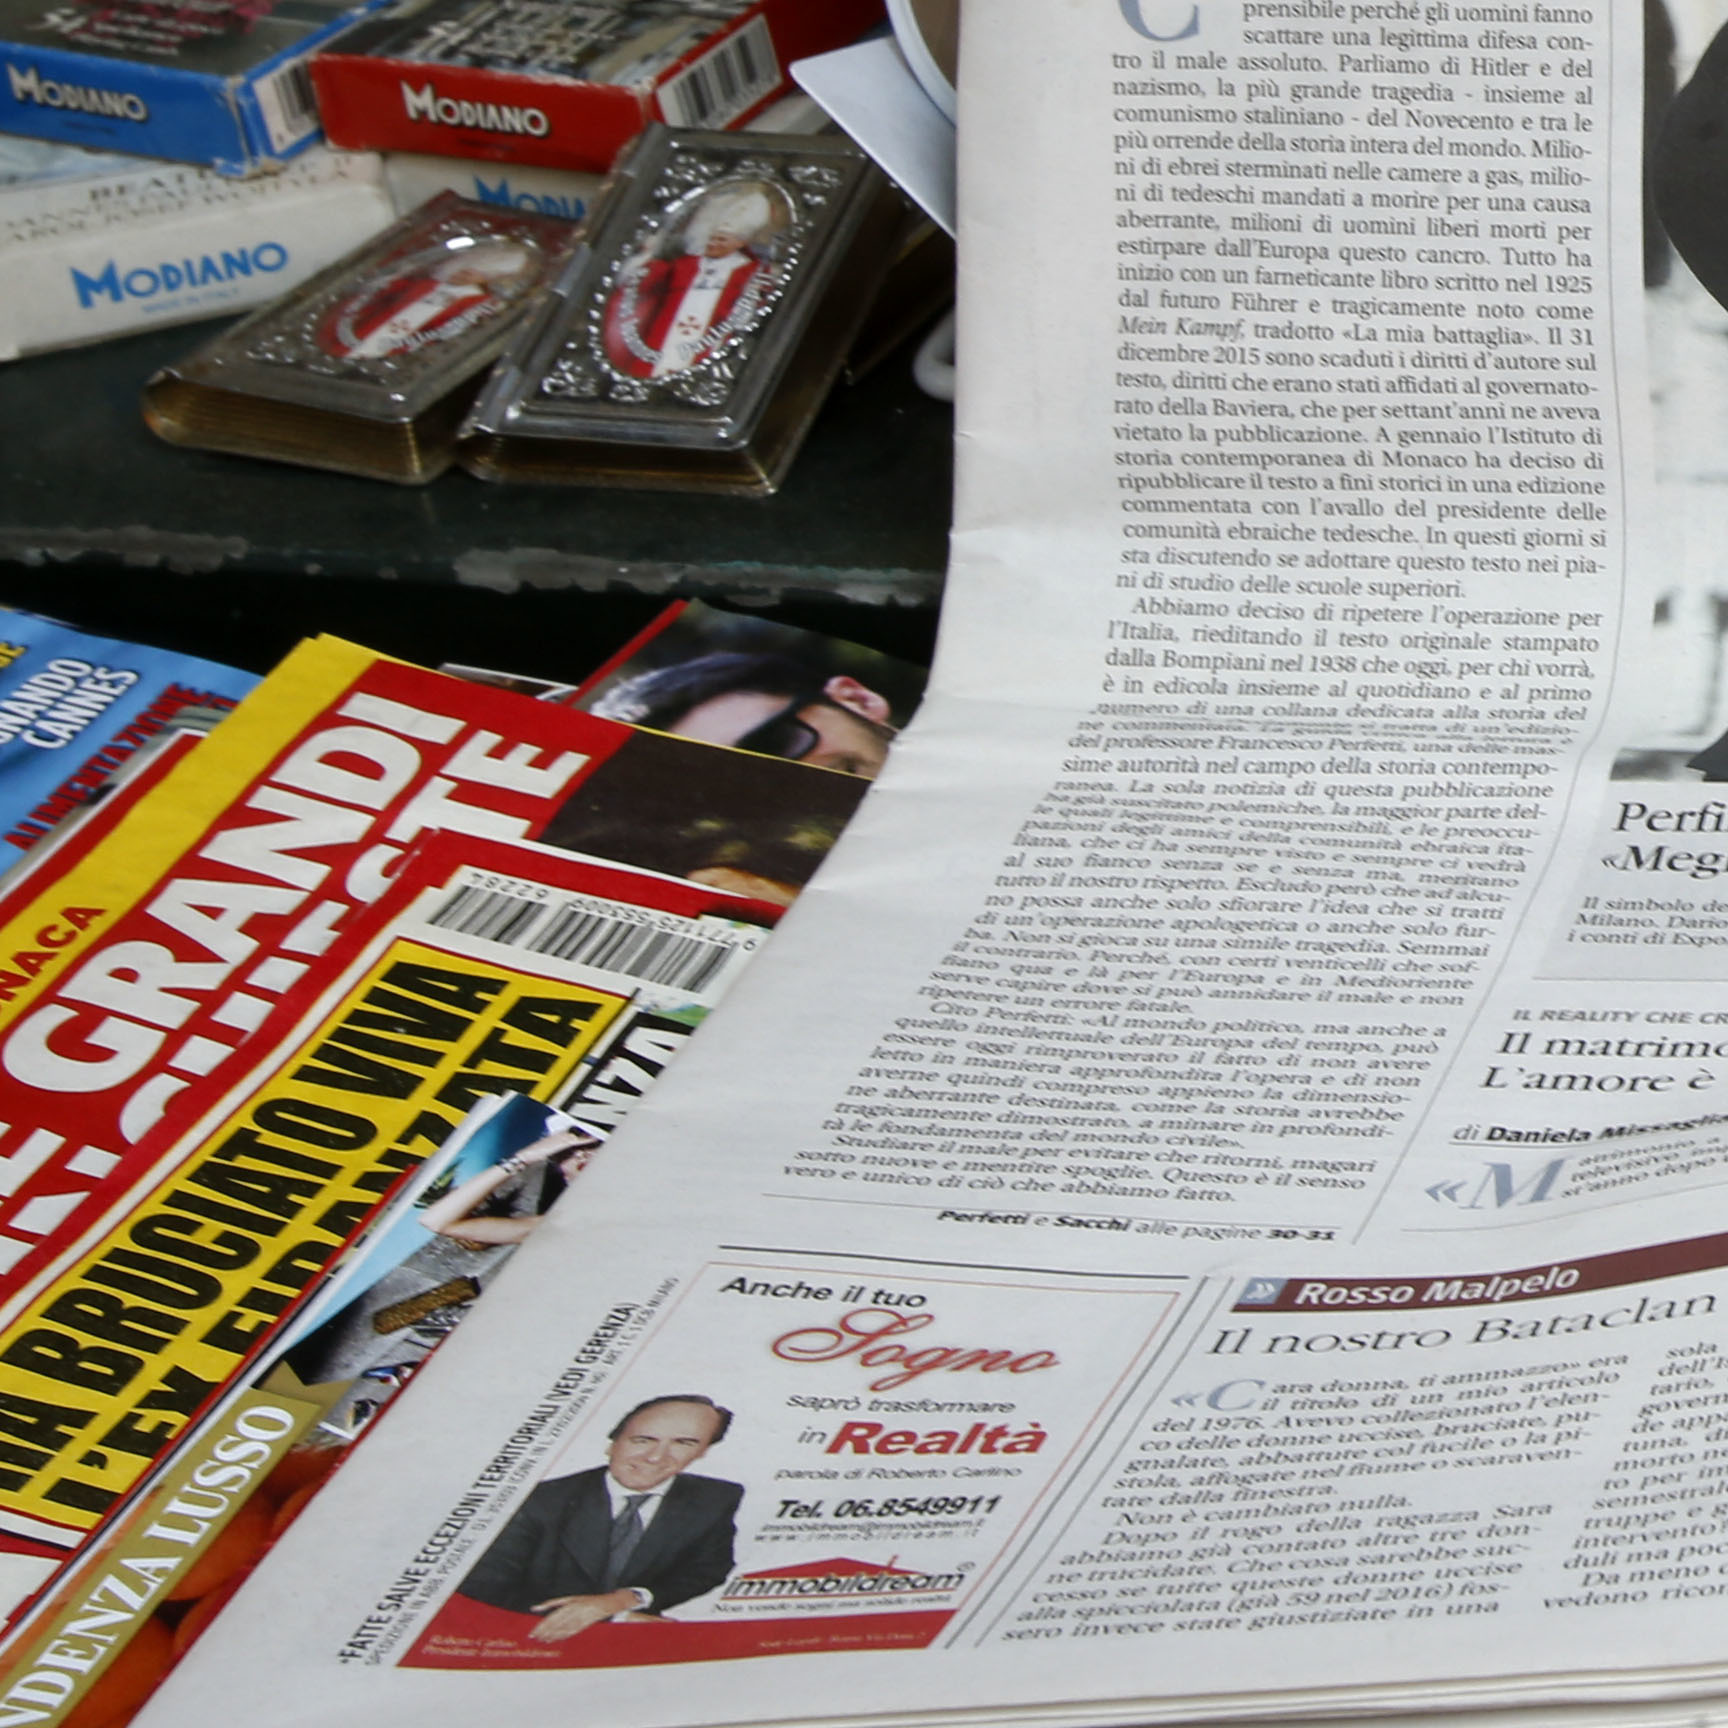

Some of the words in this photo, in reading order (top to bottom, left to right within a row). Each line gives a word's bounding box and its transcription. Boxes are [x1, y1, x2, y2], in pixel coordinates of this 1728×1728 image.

[5, 62, 149, 125] MODIANO
[402, 83, 549, 139] MODIANO
[69, 240, 289, 310] MODIANO
[20, 664, 141, 751] CANNES
[1, 691, 468, 1094] GRANDI
[1, 1097, 379, 1398] BRUCIATO
[290, 959, 511, 1102] VIVA
[1293, 1278, 1415, 1306] Rosso
[1420, 1264, 1582, 1303] Malpelo
[1205, 1327, 1254, 1357] Il
[1260, 1322, 1453, 1355] nostro
[1466, 1292, 1718, 1346] Bataclan
[141, 1404, 296, 1549] LUSSO
